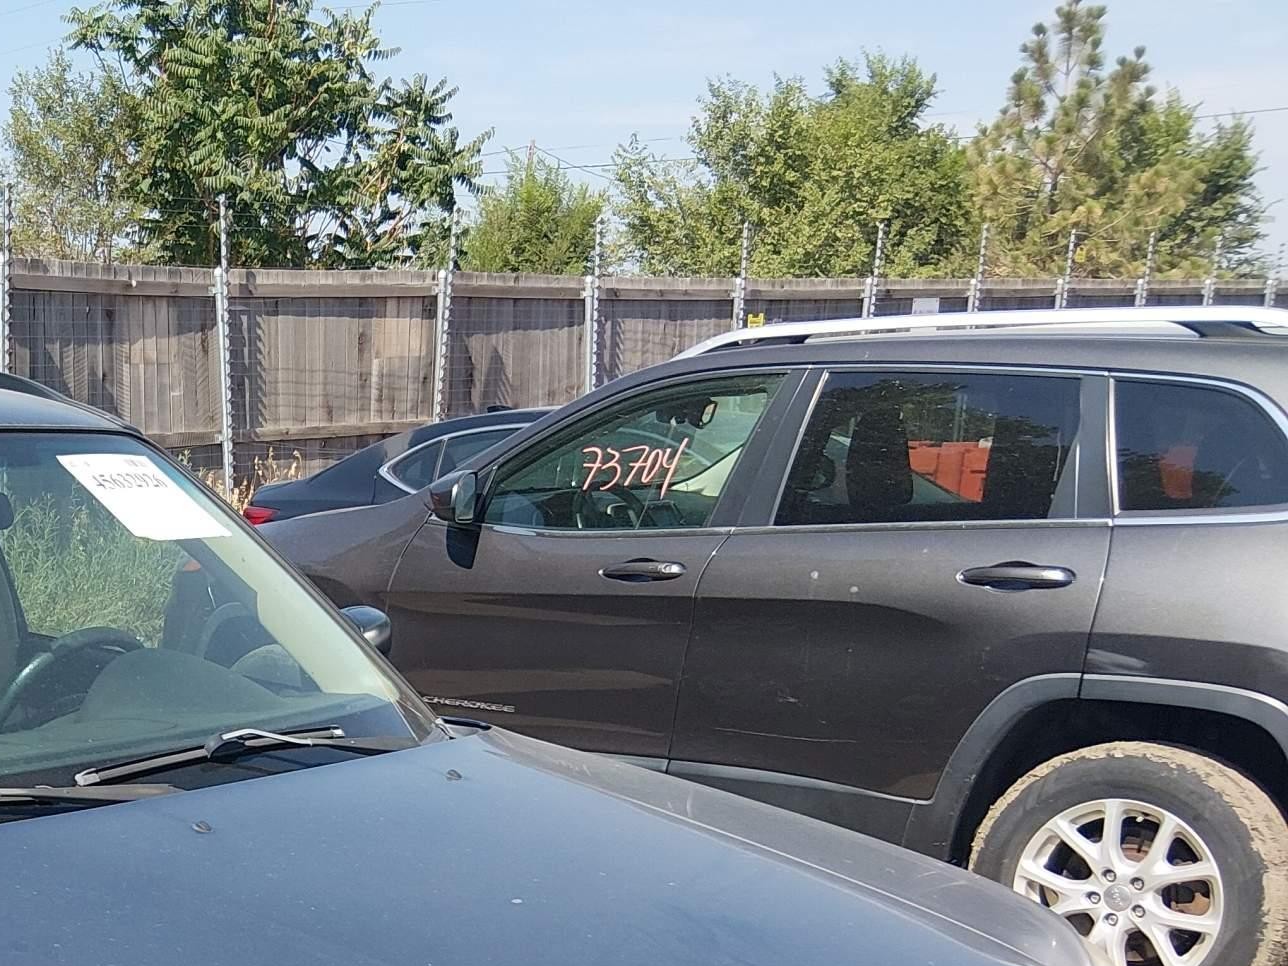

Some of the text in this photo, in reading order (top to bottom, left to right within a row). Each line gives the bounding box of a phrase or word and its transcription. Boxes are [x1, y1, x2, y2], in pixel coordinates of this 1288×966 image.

[580, 437, 689, 500] 73704
[91, 472, 169, 490] 45632926
[423, 695, 516, 713] CHEROKEE
